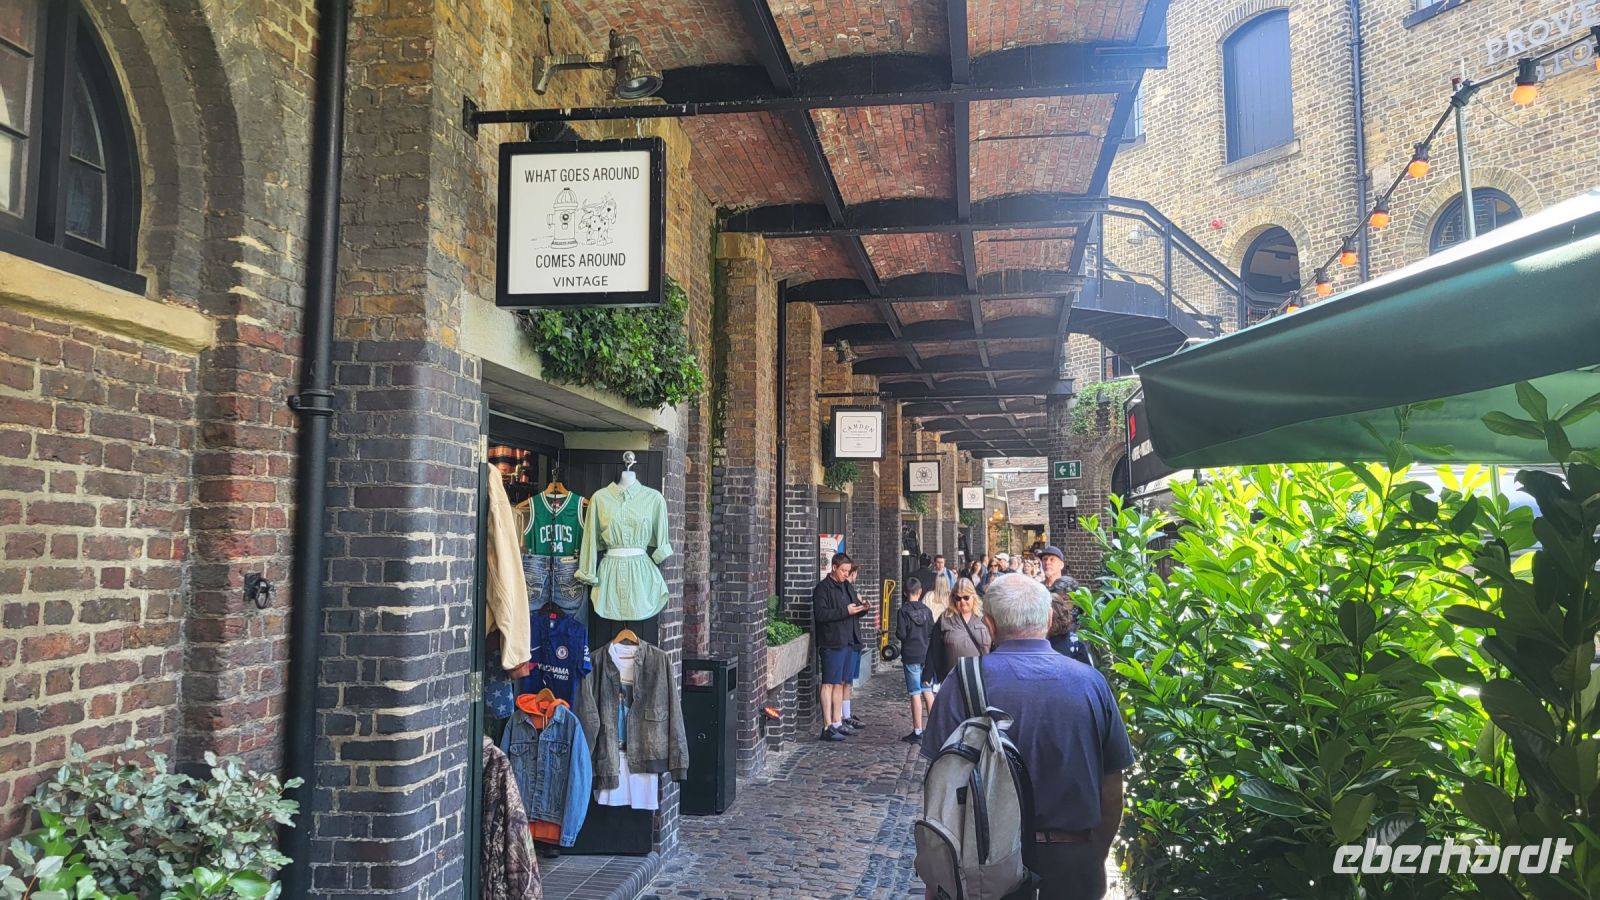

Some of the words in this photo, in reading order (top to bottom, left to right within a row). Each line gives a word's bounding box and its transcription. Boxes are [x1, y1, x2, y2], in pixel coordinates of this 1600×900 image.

[525, 169, 557, 183] WHAT
[560, 168, 590, 182] GOES
[592, 166, 640, 181] AROUND
[535, 254, 575, 268] COMES
[578, 252, 626, 267] AROUND
[553, 276, 609, 288] VINTAGE
[553, 673, 569, 681] TYRES
